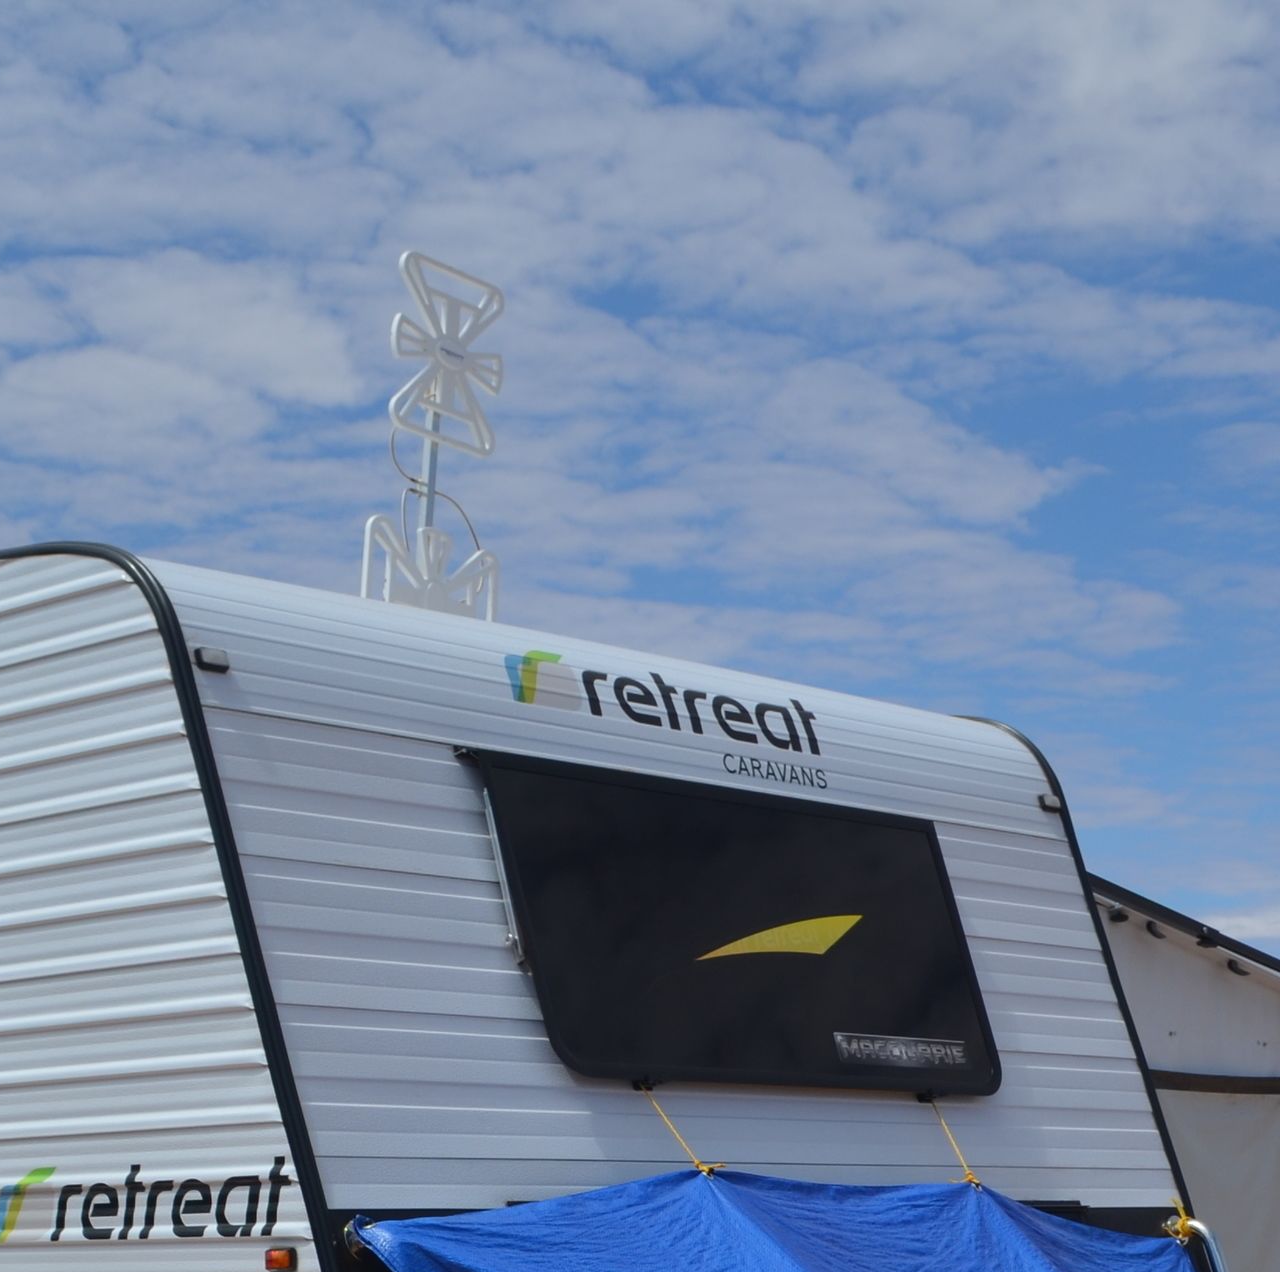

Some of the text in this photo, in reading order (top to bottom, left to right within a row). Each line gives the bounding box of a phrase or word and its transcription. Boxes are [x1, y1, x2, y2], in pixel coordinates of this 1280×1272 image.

[581, 671, 822, 756] retreat
[722, 753, 828, 789] CARAVANS
[50, 1155, 293, 1242] retreat
